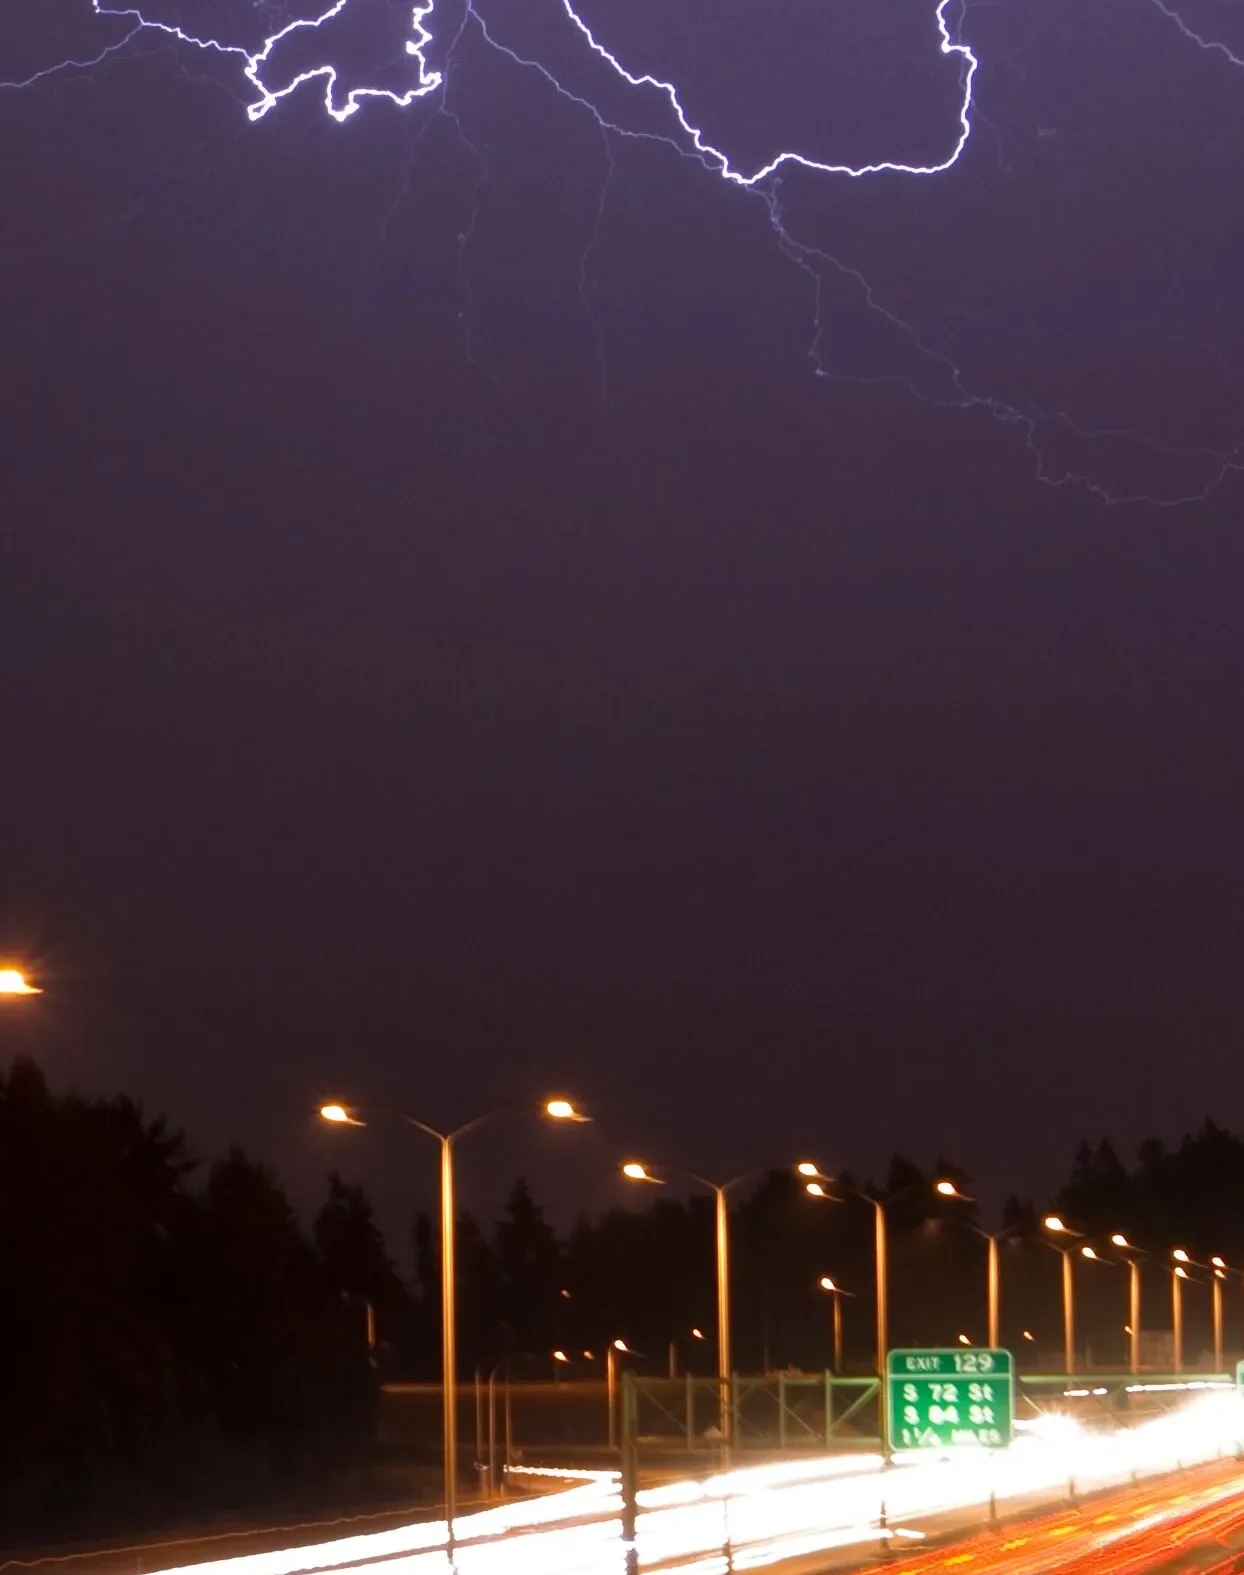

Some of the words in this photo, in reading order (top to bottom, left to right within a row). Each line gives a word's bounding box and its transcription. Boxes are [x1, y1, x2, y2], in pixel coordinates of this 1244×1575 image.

[905, 1356, 940, 1371] EXIT
[954, 1353, 993, 1372] 129
[903, 1383, 919, 1402] S
[928, 1383, 959, 1402] 72
[968, 1383, 994, 1402] St
[903, 1405, 920, 1425] S
